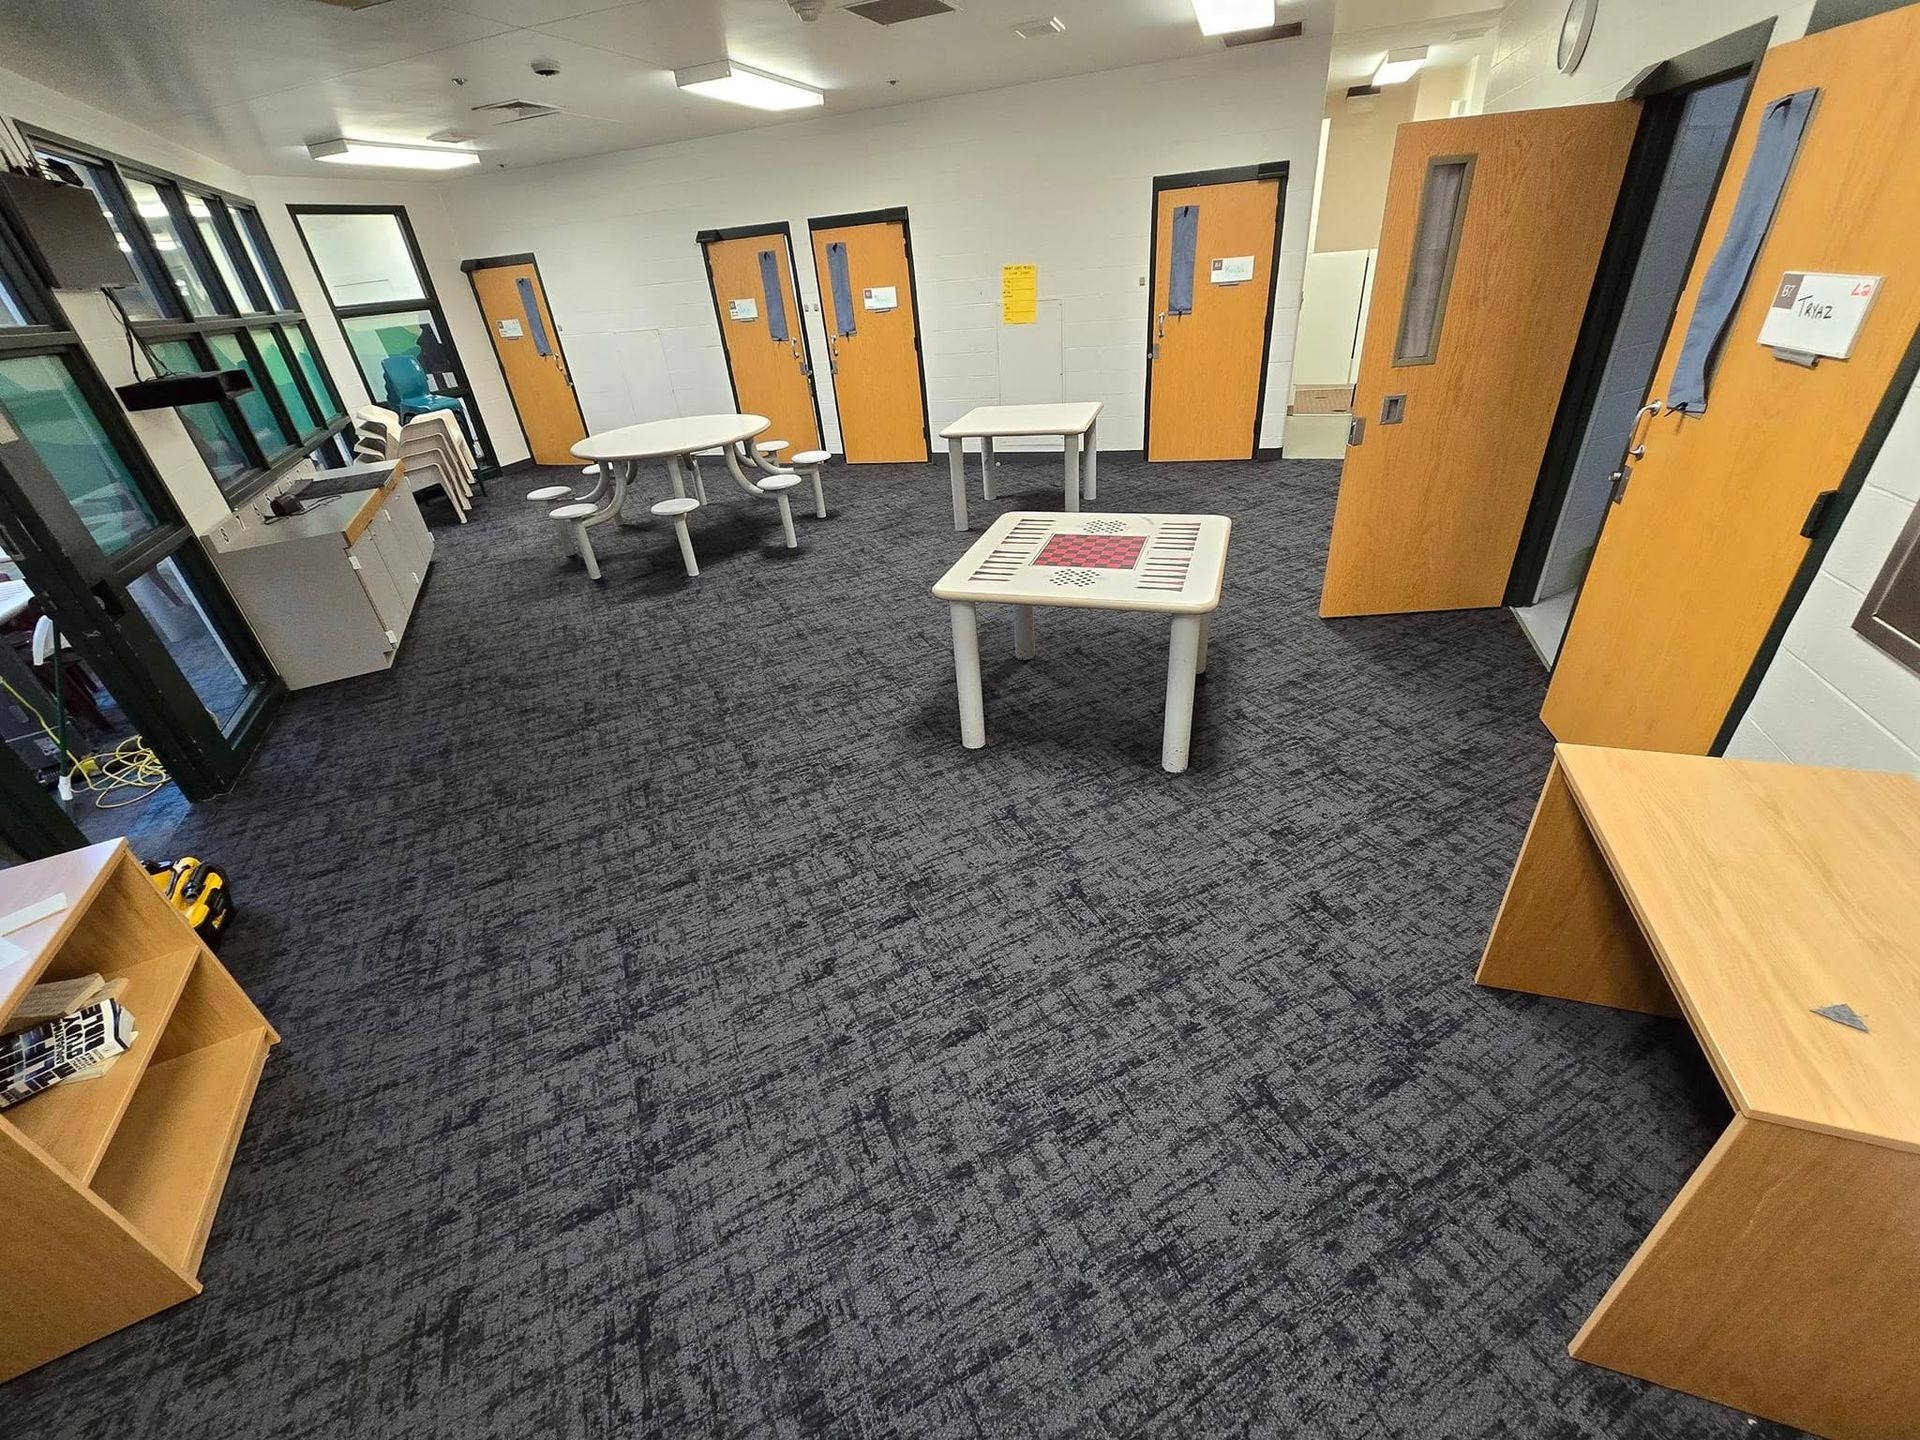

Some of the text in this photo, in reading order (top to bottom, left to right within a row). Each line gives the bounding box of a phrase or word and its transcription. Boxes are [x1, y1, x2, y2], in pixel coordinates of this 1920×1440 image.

[1781, 284, 1796, 298] B7
[62, 1014, 84, 1060] STUDY
[80, 1002, 105, 1053] BIBLE
